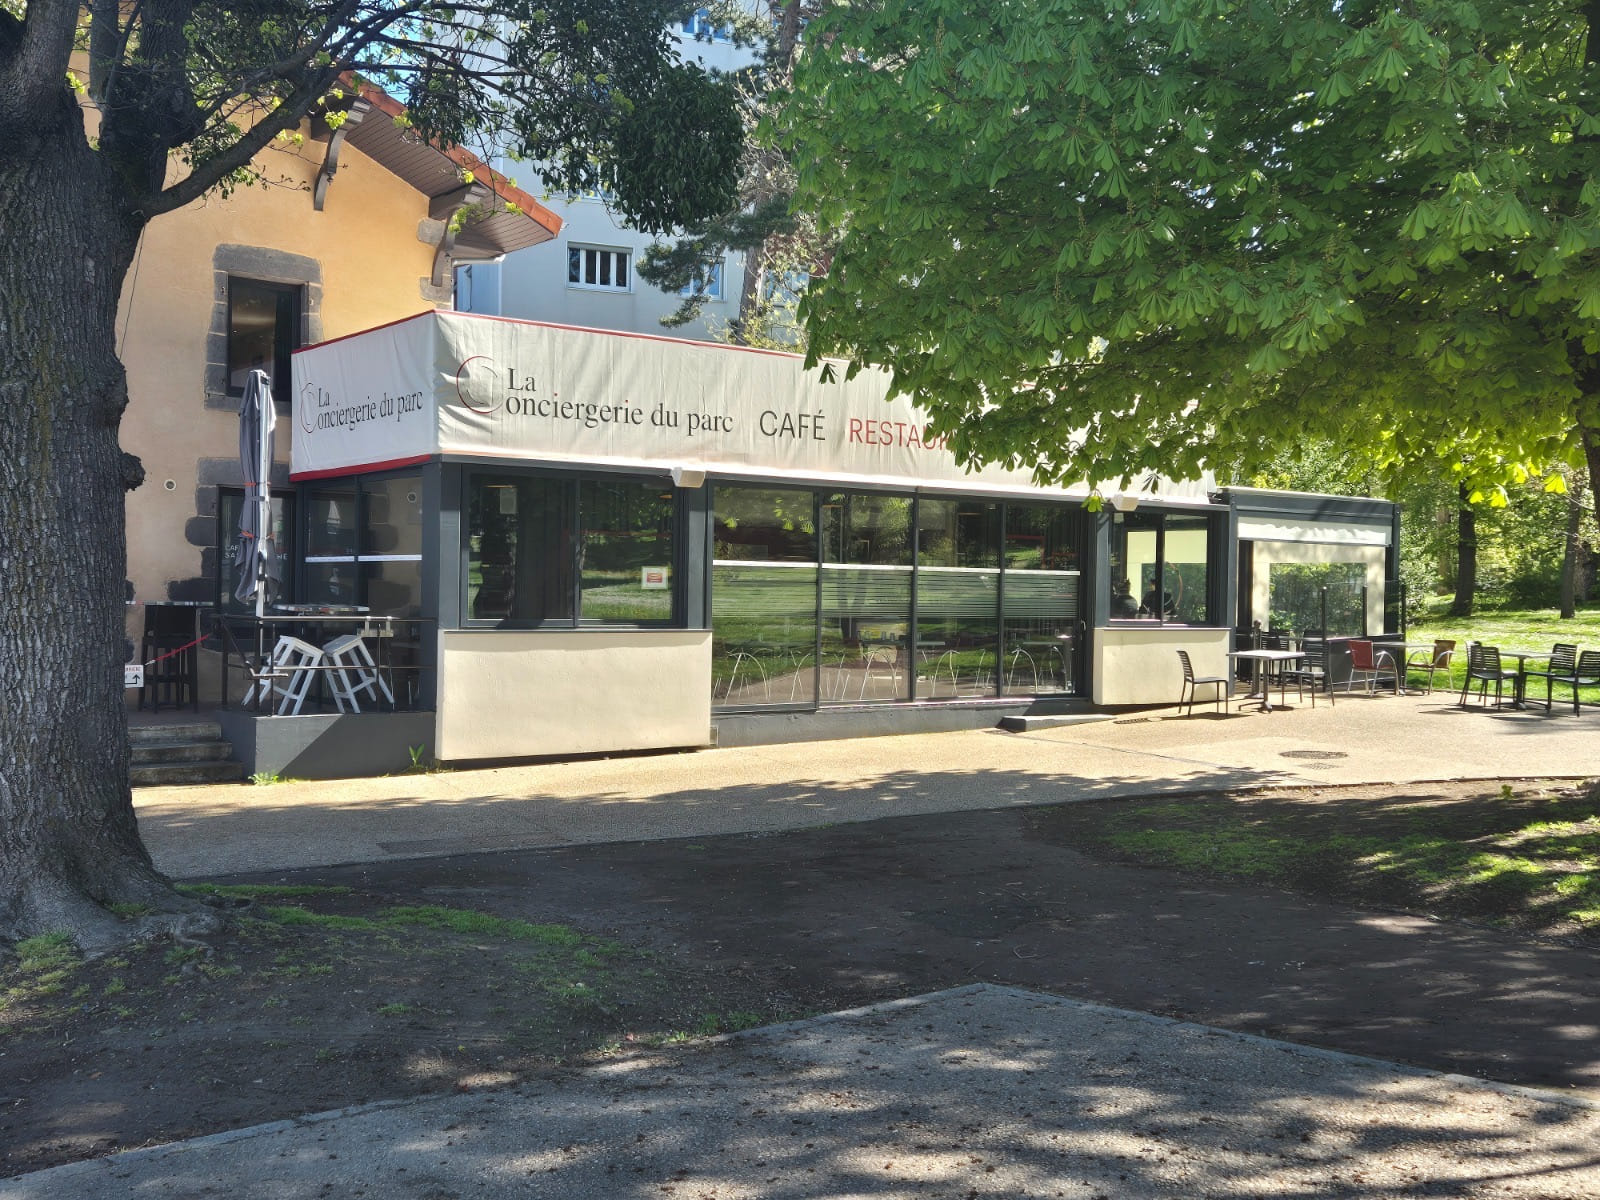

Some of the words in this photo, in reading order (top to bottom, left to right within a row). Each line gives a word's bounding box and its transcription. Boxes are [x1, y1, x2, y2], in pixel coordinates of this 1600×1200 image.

[507, 367, 537, 392] La
[318, 387, 330, 408] La
[379, 391, 394, 419] du
[397, 391, 423, 422] parc
[650, 402, 678, 428] du
[687, 411, 733, 436] parc
[759, 409, 826, 441] CAFÉ
